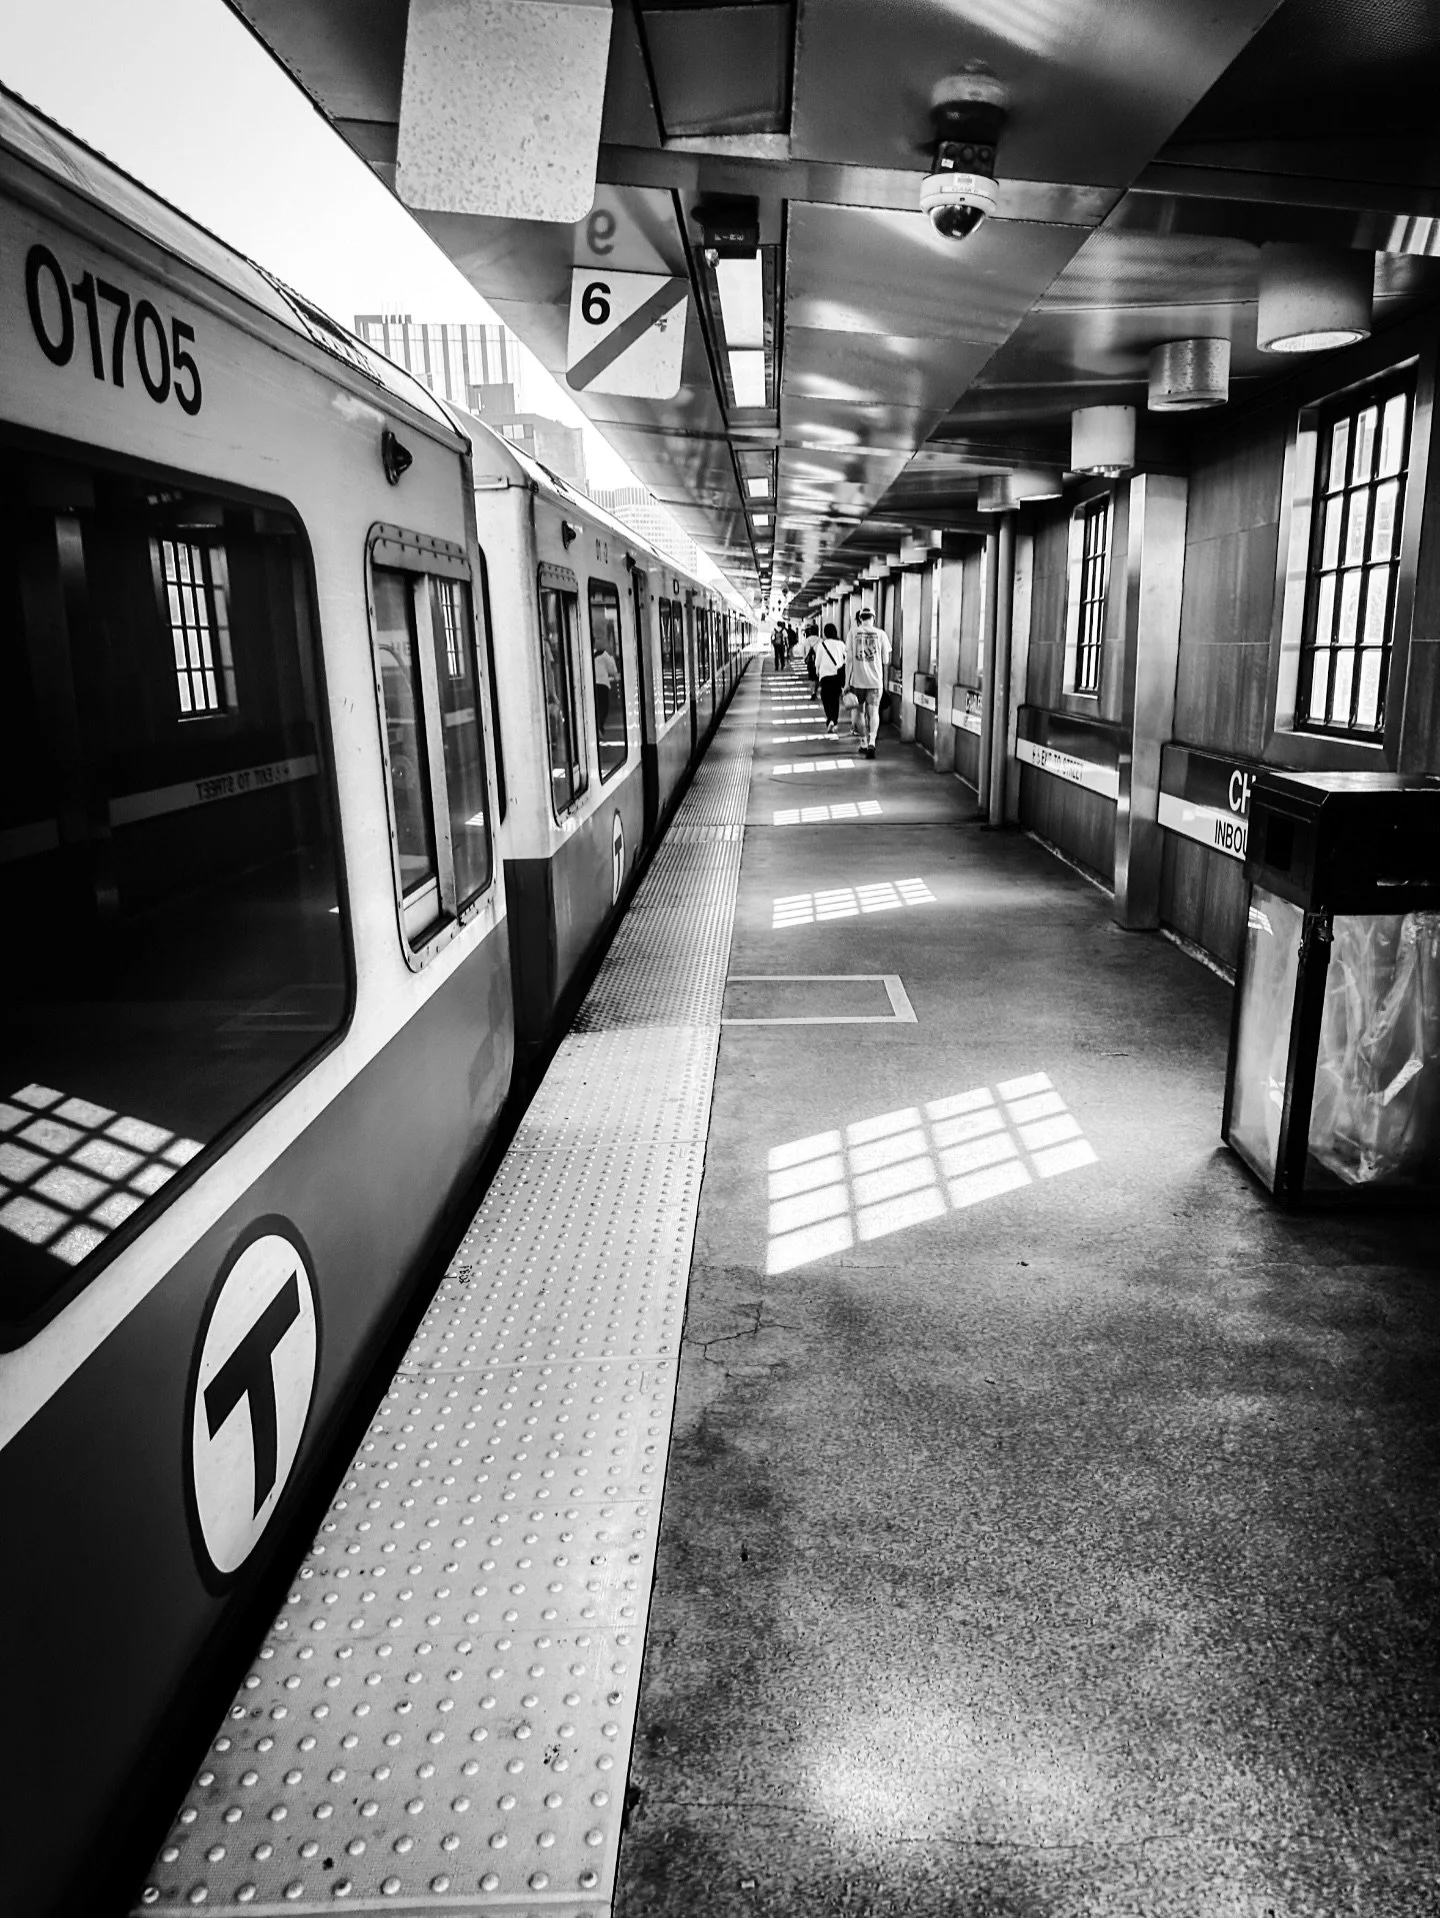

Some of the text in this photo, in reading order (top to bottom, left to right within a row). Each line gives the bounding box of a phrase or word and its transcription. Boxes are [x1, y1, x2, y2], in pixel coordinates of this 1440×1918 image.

[25, 244, 202, 416] 01705
[581, 282, 611, 325] 6
[203, 1269, 301, 1522] T
